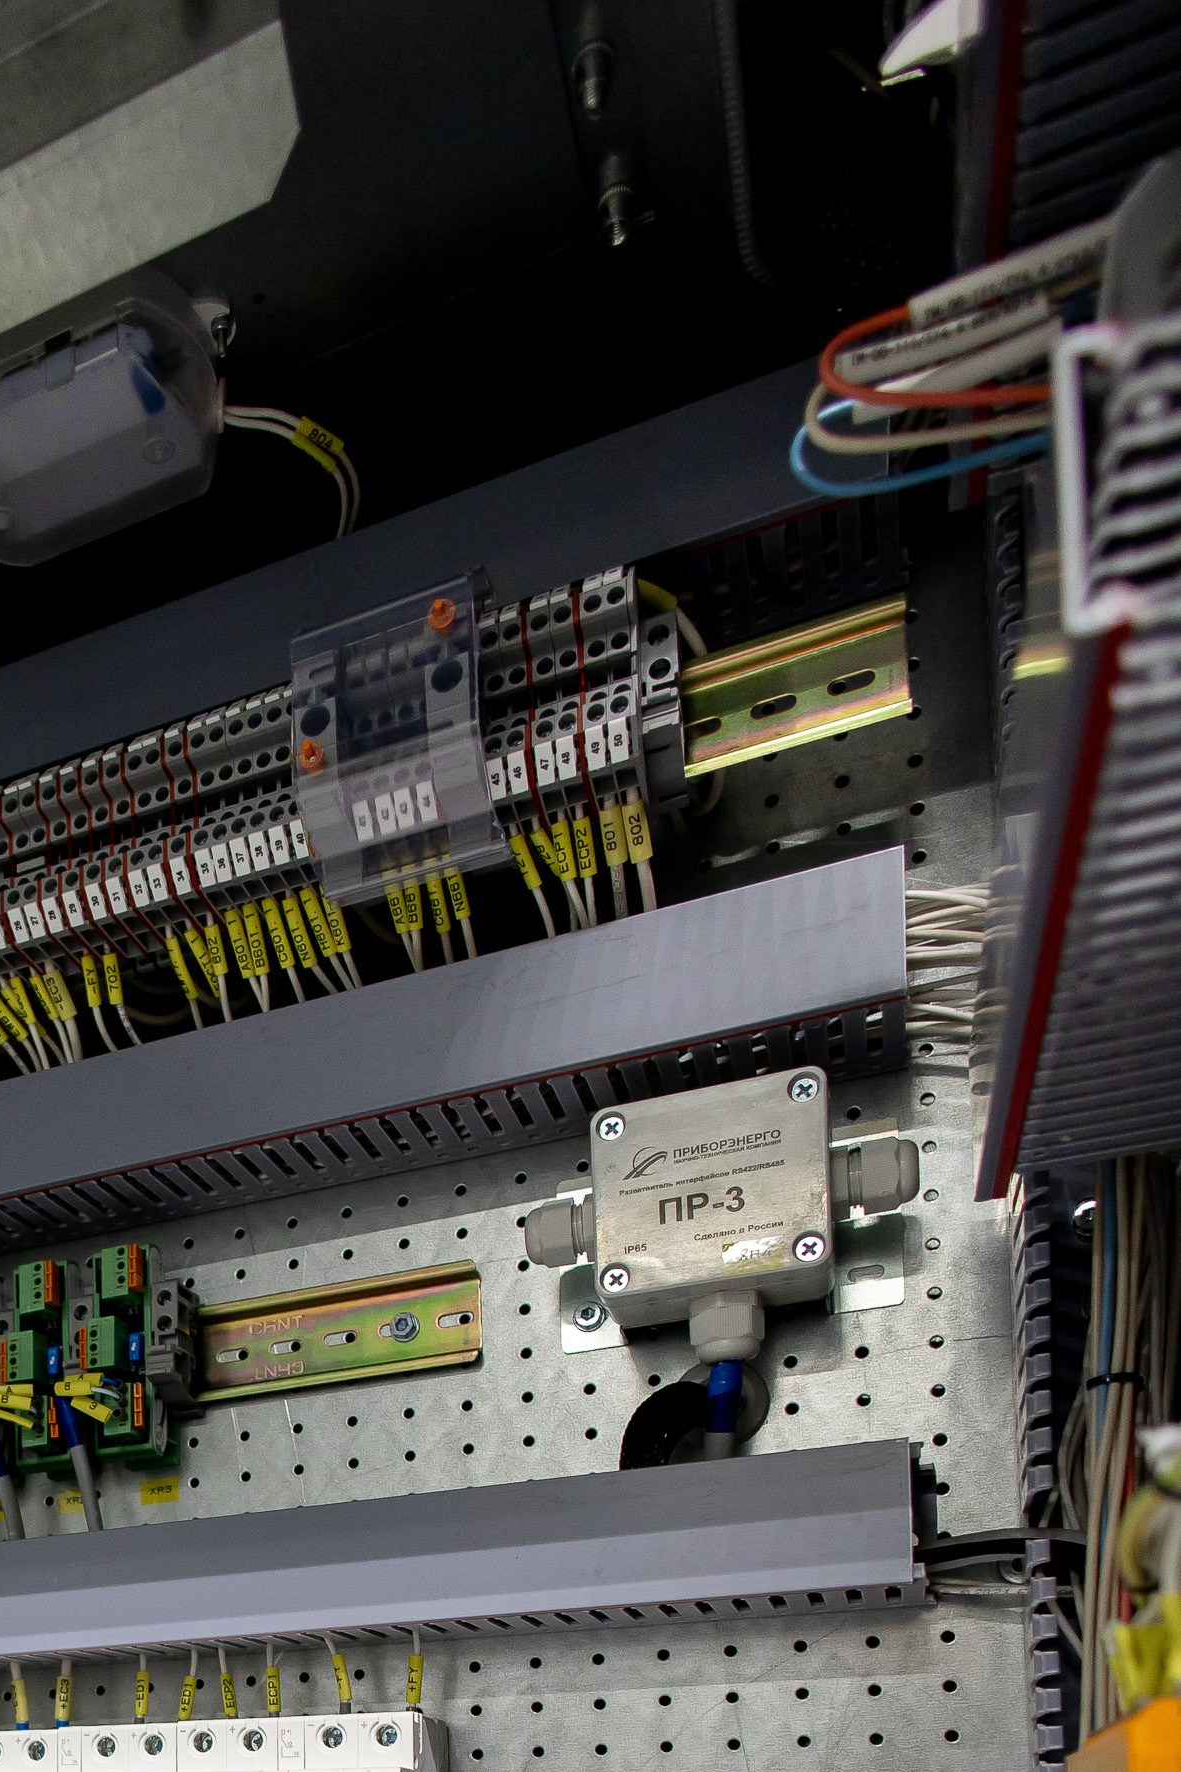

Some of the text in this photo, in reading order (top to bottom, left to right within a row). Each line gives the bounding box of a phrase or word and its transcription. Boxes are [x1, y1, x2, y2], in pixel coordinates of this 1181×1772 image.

[308, 427, 334, 449] 804
[613, 733, 624, 747] 50
[590, 741, 601, 755] 49
[538, 758, 550, 771] 47
[561, 751, 572, 765] 48
[490, 772, 501, 786] 45
[513, 765, 523, 780] 46
[605, 821, 618, 852] 801
[630, 813, 645, 847] 802
[275, 839, 285, 852] 39
[295, 833, 307, 845] 40
[255, 845, 265, 858] 38
[556, 832, 570, 874] ECP1
[578, 827, 592, 871] ECP2
[217, 857, 227, 870] 36
[237, 851, 246, 864] 37
[202, 862, 211, 874] 35
[152, 876, 162, 890] 33
[177, 869, 186, 883] 34
[135, 883, 144, 895] 32
[91, 895, 100, 908] 30
[113, 890, 122, 903] 31
[106, 964, 120, 994] 702
[673, 1129, 782, 1159] ПРИБОРЭНЕРГО
[659, 1185, 746, 1225] ПР-3
[694, 1229, 736, 1242] Сделано
[747, 1220, 784, 1234] России
[623, 1242, 647, 1255] IP65
[4, 1385, 14, 1395] A
[64, 1381, 72, 1391] B
[0, 1395, 9, 1404] B
[408, 1667, 419, 1694] +FY
[59, 1678, 70, 1710] +EC3
[135, 1679, 146, 1708] -ED1
[223, 1678, 236, 1709] ECP2
[268, 1673, 279, 1706] ECP1
[180, 1682, 194, 1713] +ED1
